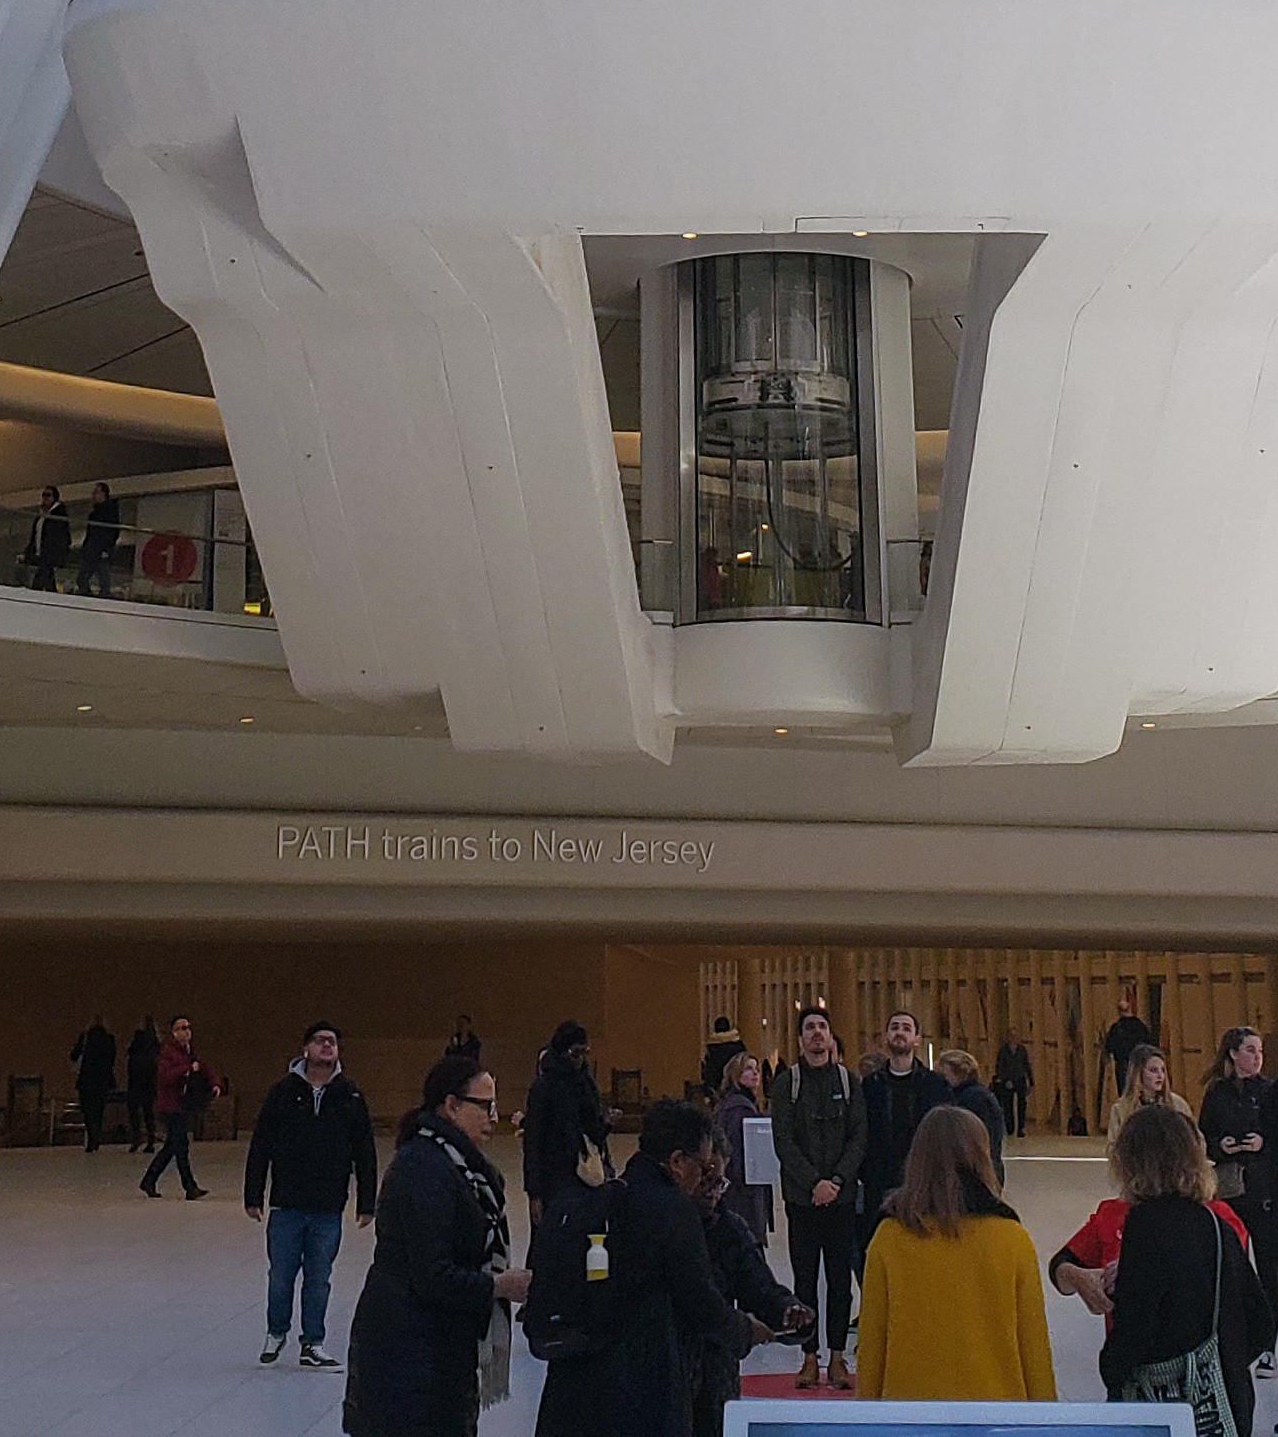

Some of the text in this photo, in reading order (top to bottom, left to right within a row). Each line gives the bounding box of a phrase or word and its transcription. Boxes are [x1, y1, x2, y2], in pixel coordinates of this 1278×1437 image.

[160, 544, 174, 575] 1
[276, 826, 716, 874] PATH trains to New Jersey
